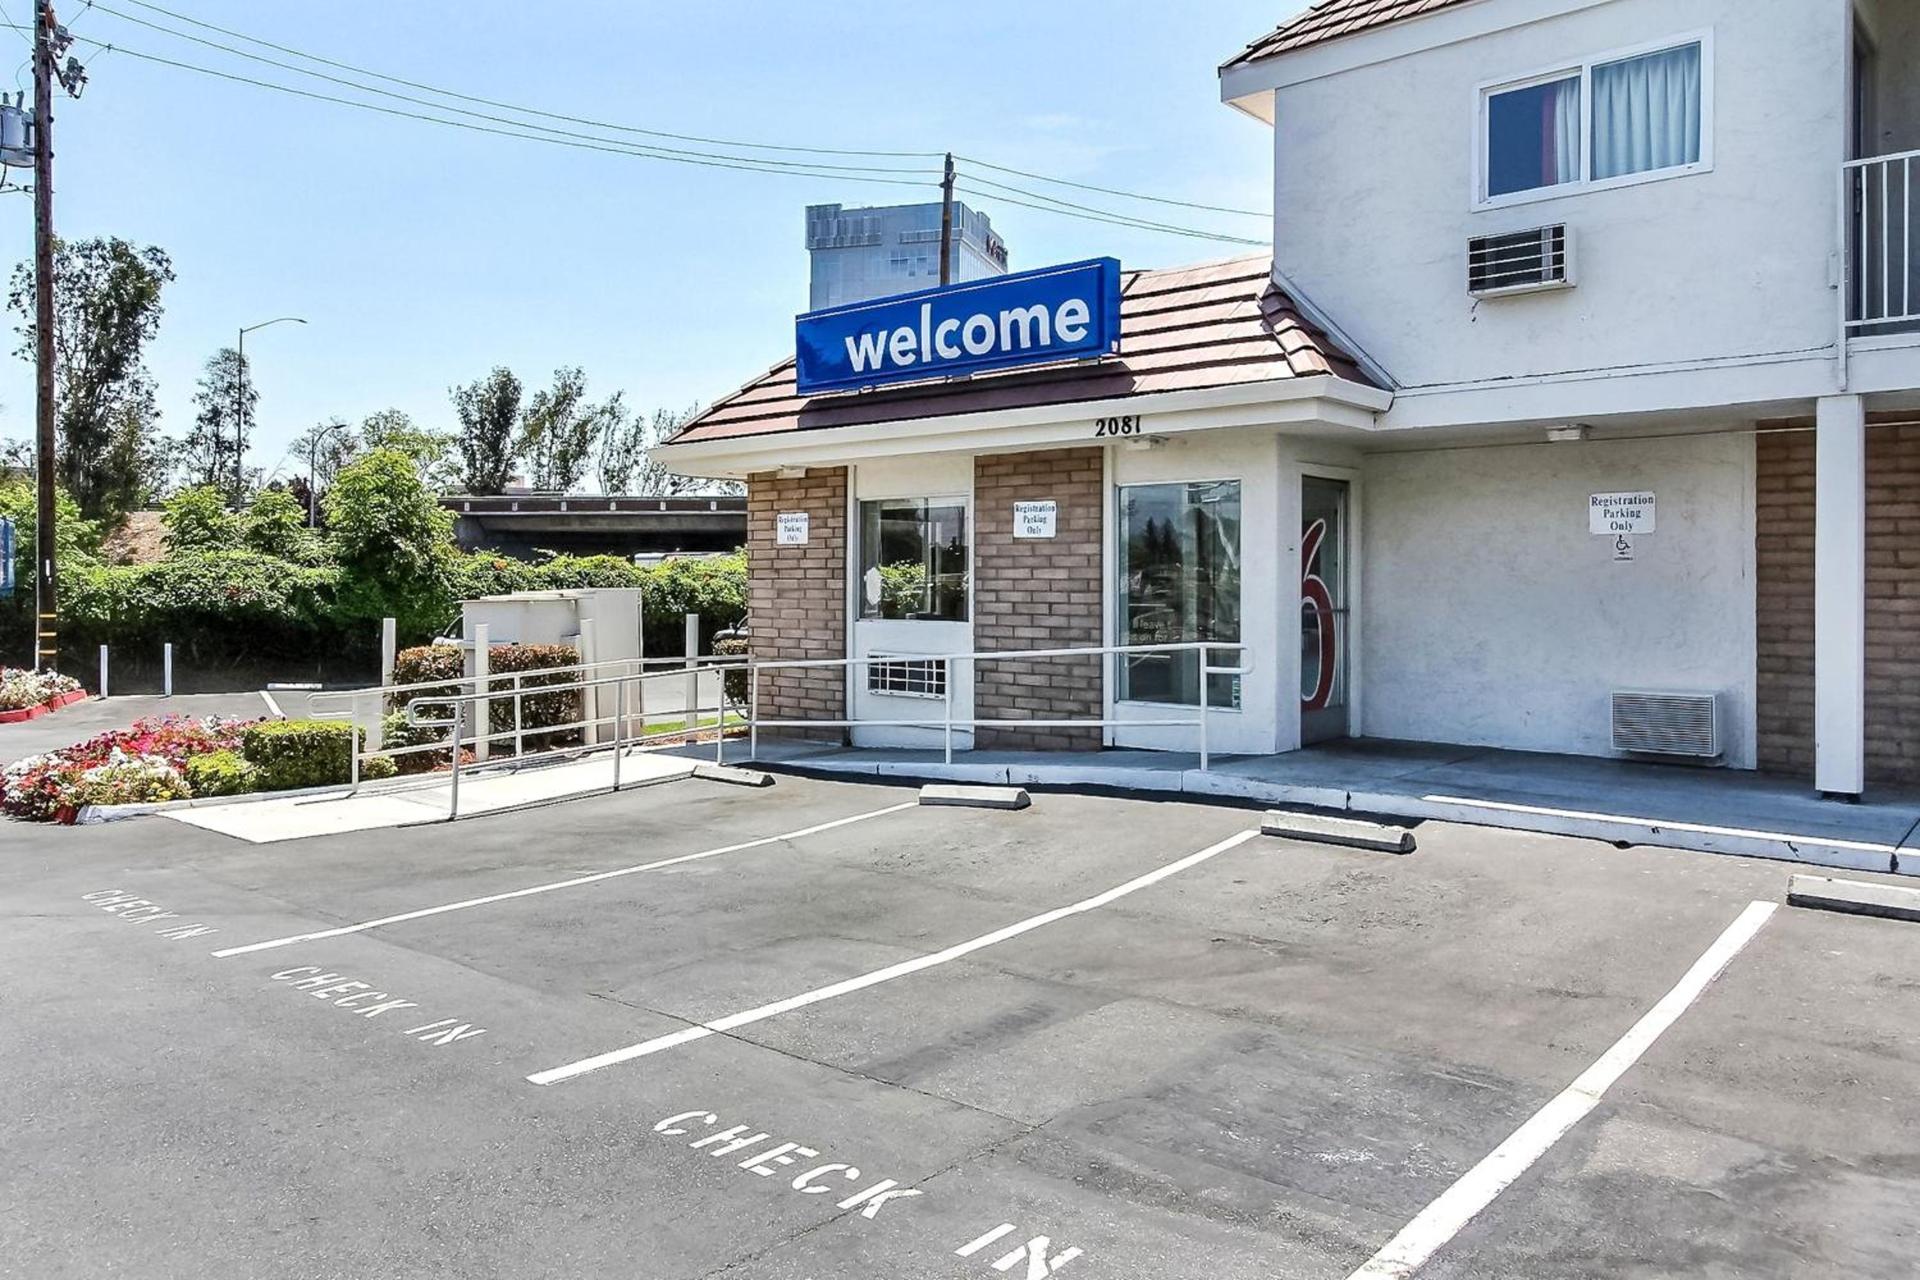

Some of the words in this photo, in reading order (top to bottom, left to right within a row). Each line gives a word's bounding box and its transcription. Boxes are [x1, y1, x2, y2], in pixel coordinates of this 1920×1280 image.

[845, 298, 1091, 372] welcome
[1095, 414, 1141, 437] 2081
[1591, 495, 1654, 507] Registration
[1603, 508, 1641, 519] Parking
[1610, 520, 1633, 532] Only
[81, 889, 180, 925] CHECK
[154, 923, 220, 941] IN
[271, 966, 419, 1018] CHECK
[402, 1018, 487, 1046] IN
[653, 1110, 923, 1219] CHECK
[954, 1222, 1084, 1280] IN
